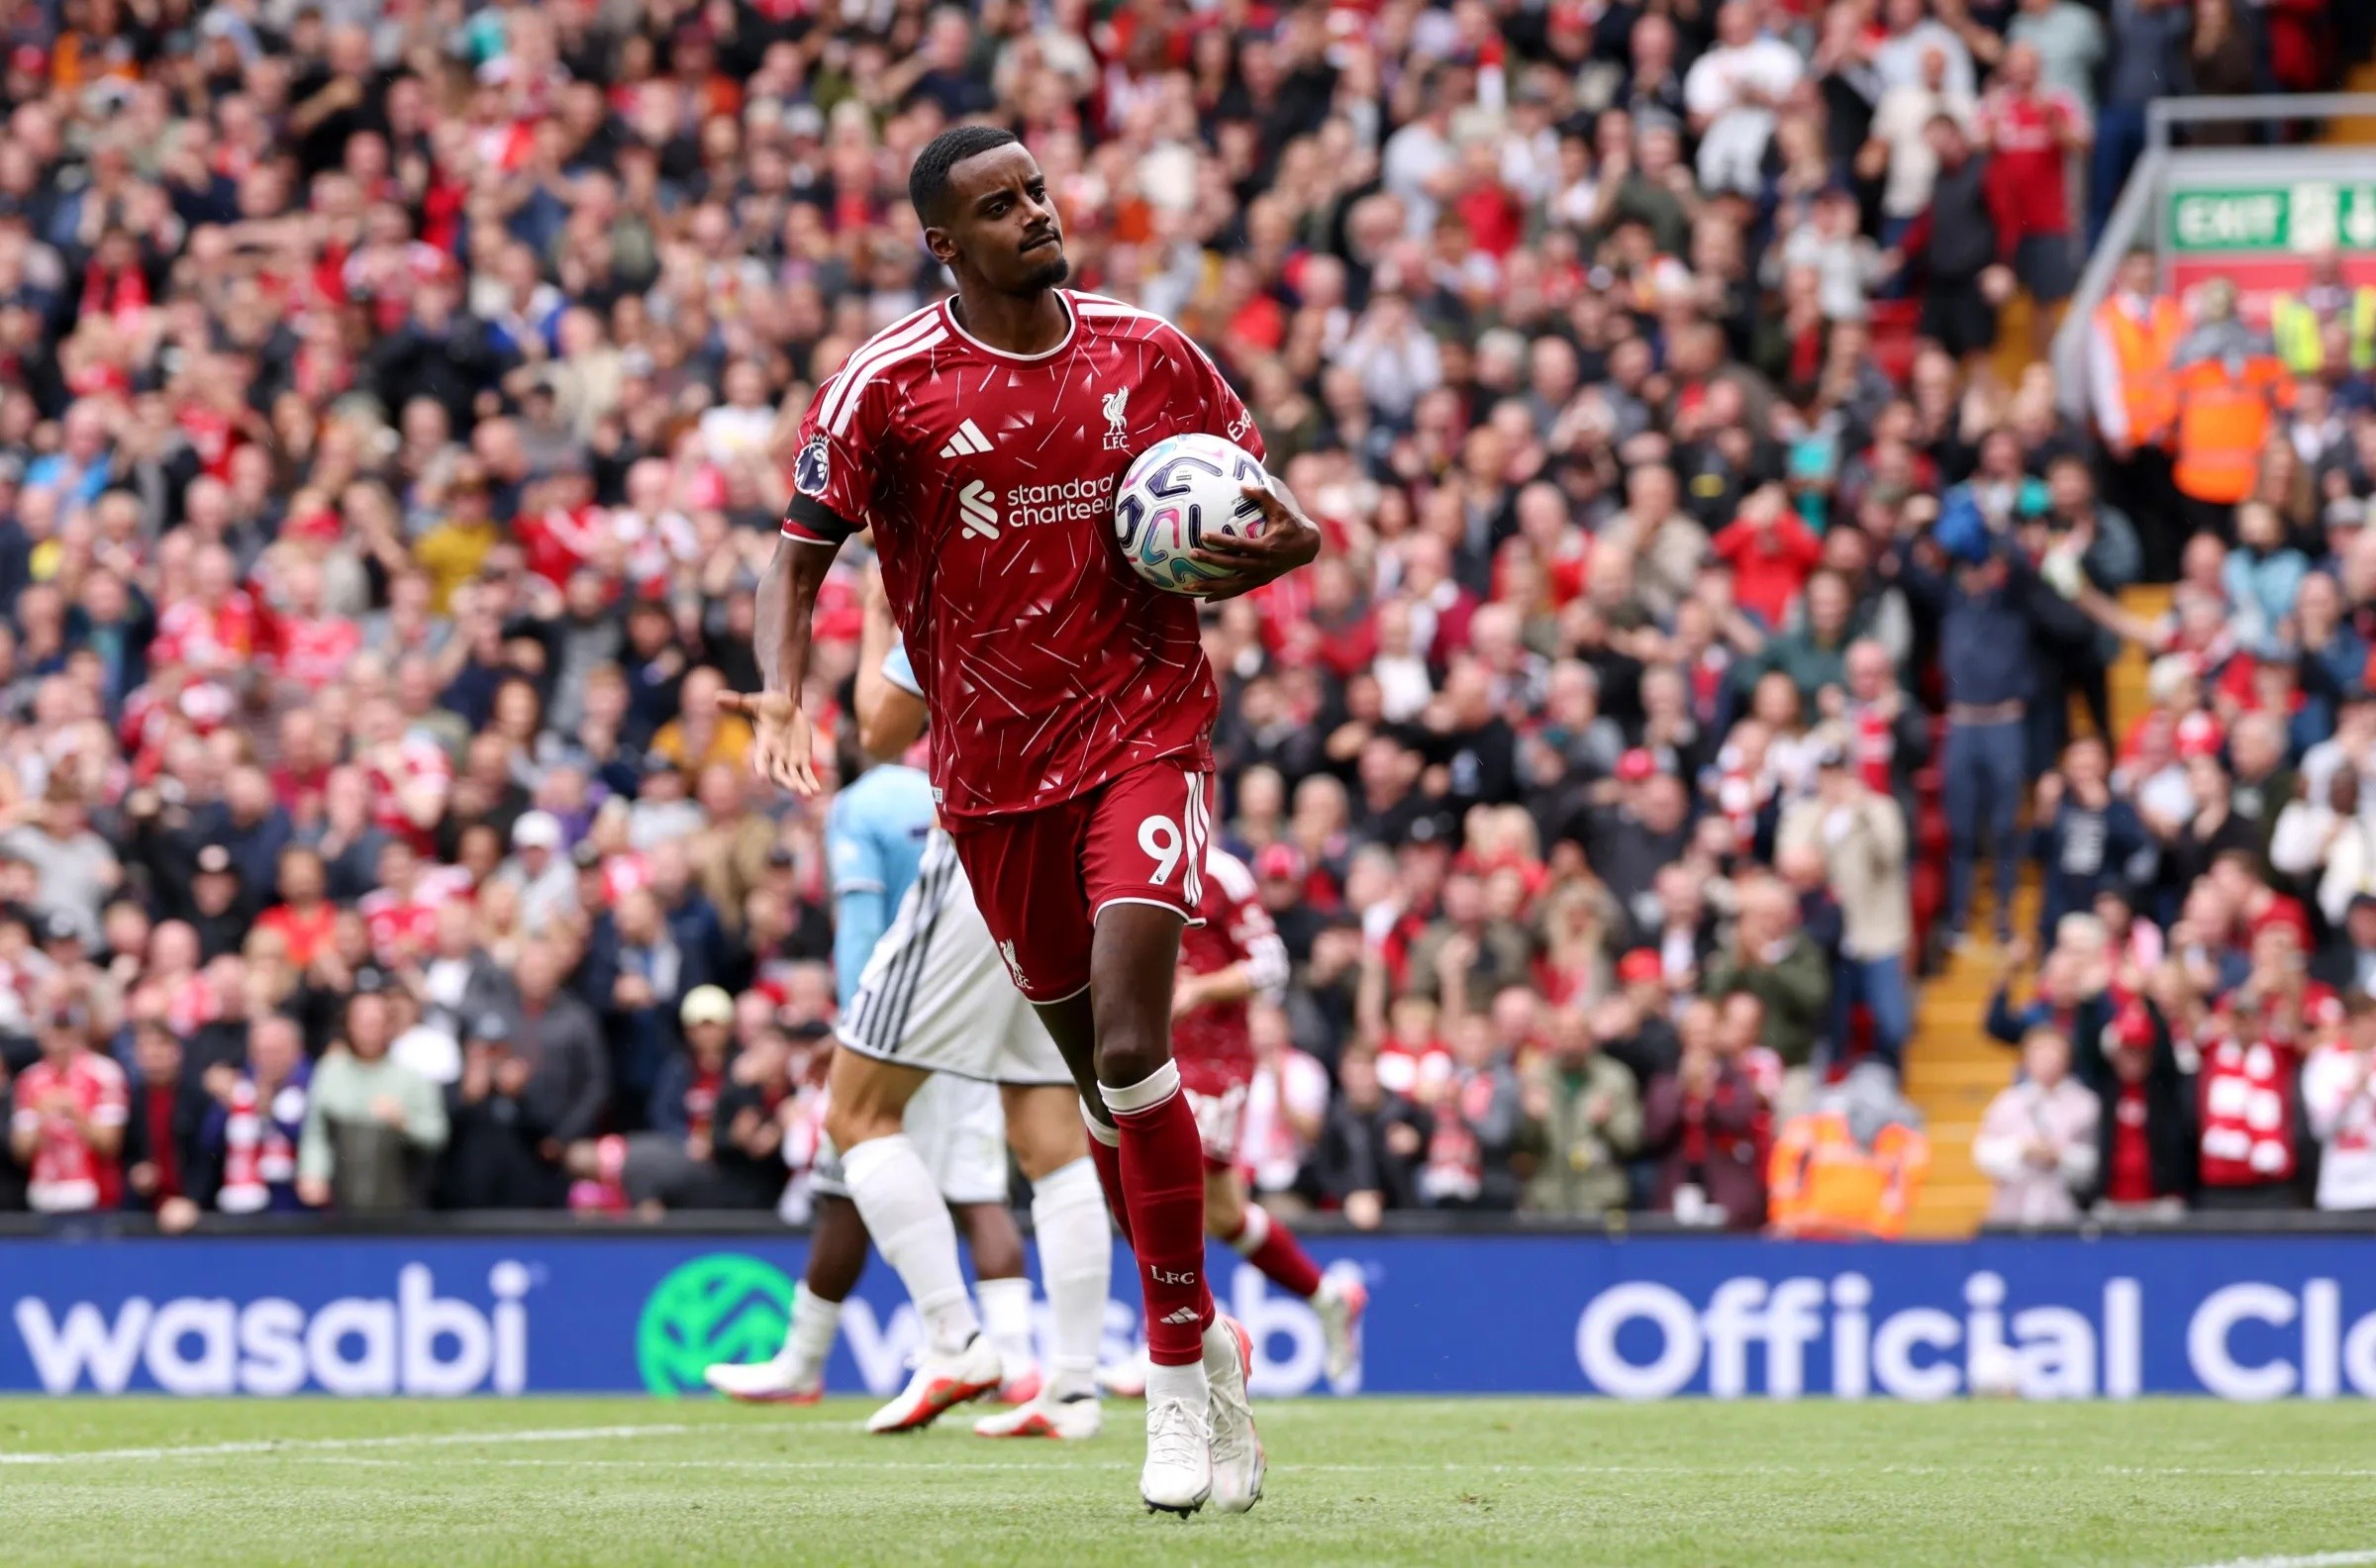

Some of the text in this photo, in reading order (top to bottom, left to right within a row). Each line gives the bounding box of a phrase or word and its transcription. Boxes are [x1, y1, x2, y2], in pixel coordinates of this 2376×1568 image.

[1009, 491, 1114, 528] charteed
[1138, 815, 1182, 886] 9
[1150, 1264, 1195, 1285] LFC
[13, 1259, 530, 1397] wasabi
[1574, 1270, 2142, 1401] Official
